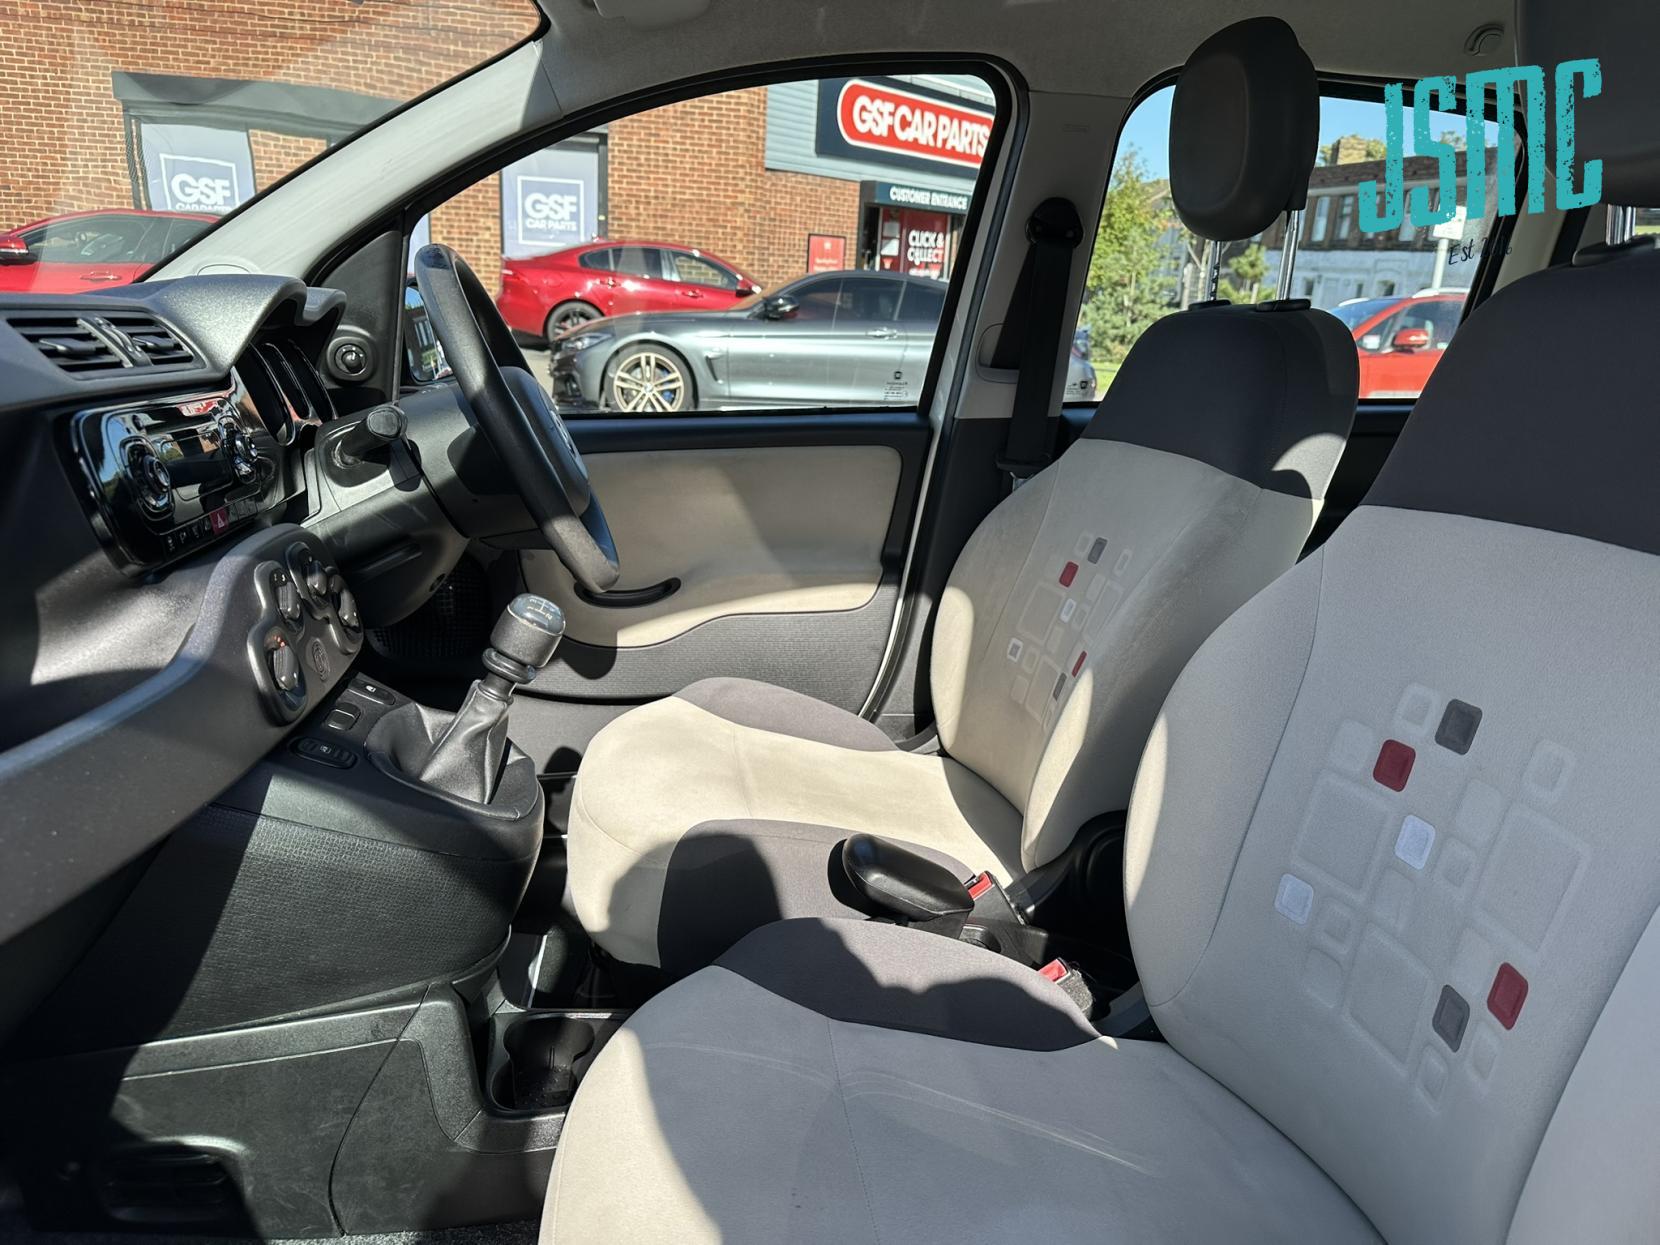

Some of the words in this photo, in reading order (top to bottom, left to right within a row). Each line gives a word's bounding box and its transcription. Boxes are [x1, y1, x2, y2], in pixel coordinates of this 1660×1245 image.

[853, 95, 895, 137] GSF
[894, 105, 937, 147] CAR
[936, 115, 991, 156] PARTS
[171, 173, 231, 205] GSF
[890, 186, 931, 205] CUSTOMER
[931, 191, 968, 210] ENTRANCE
[524, 192, 577, 220] GSF
[908, 230, 937, 248] CLICK
[907, 247, 944, 263] COLLECT
